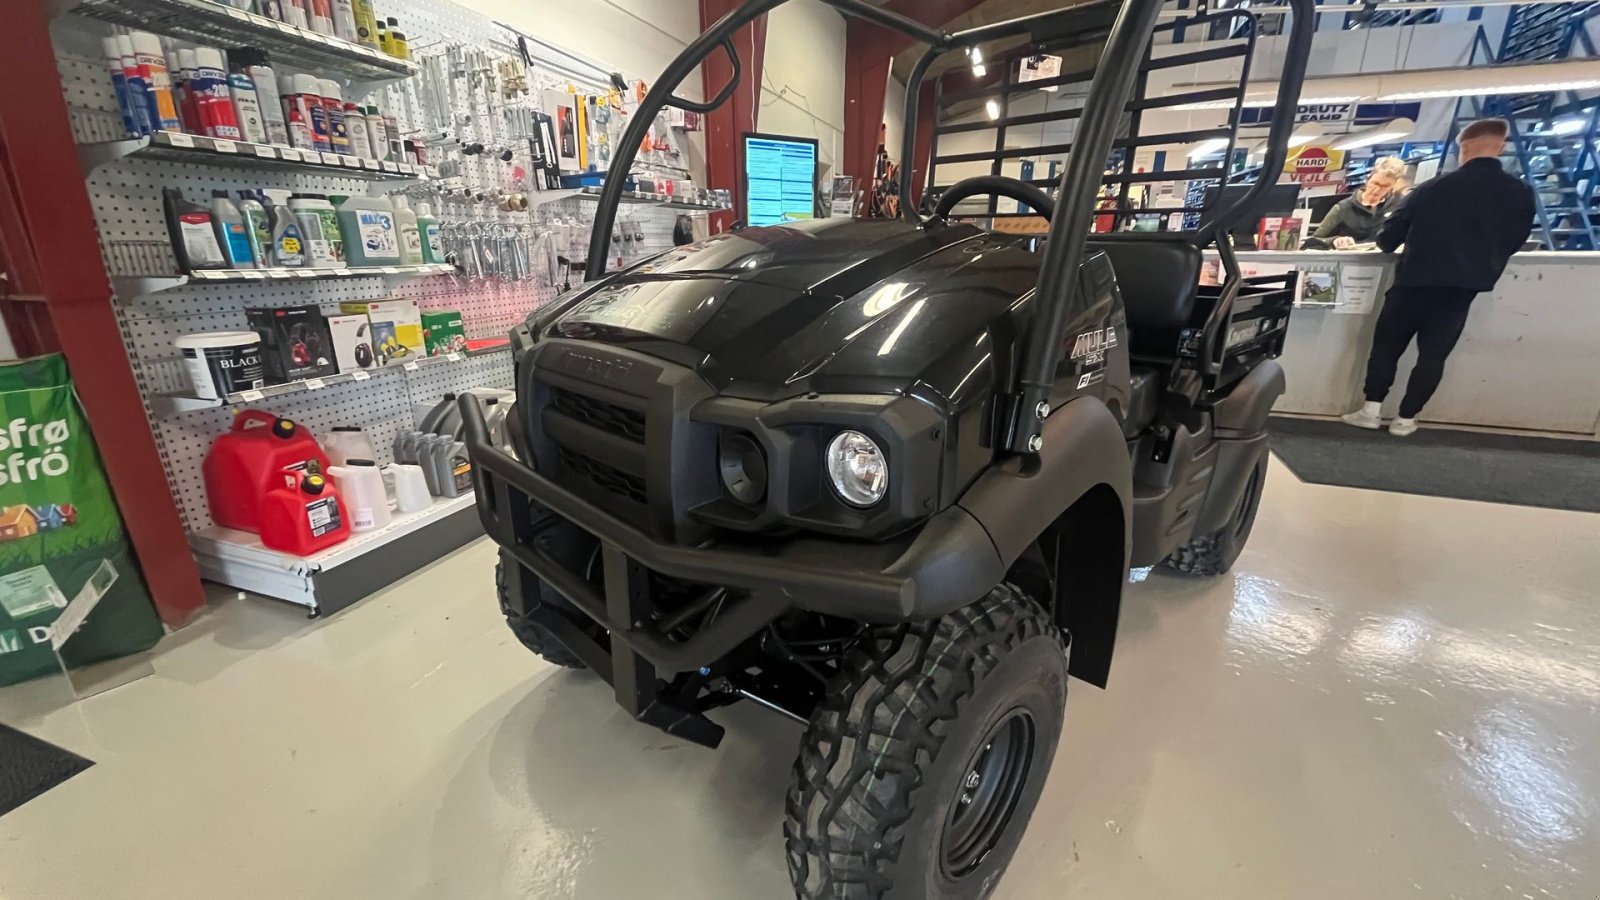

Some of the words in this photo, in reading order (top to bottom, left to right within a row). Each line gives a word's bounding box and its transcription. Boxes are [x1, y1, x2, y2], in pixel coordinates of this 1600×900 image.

[1297, 104, 1350, 113] DEUTZ
[1296, 158, 1328, 167] HARDI
[1290, 173, 1331, 182] VEJLE
[1070, 327, 1118, 359] MULE
[220, 356, 259, 369] BLACK
